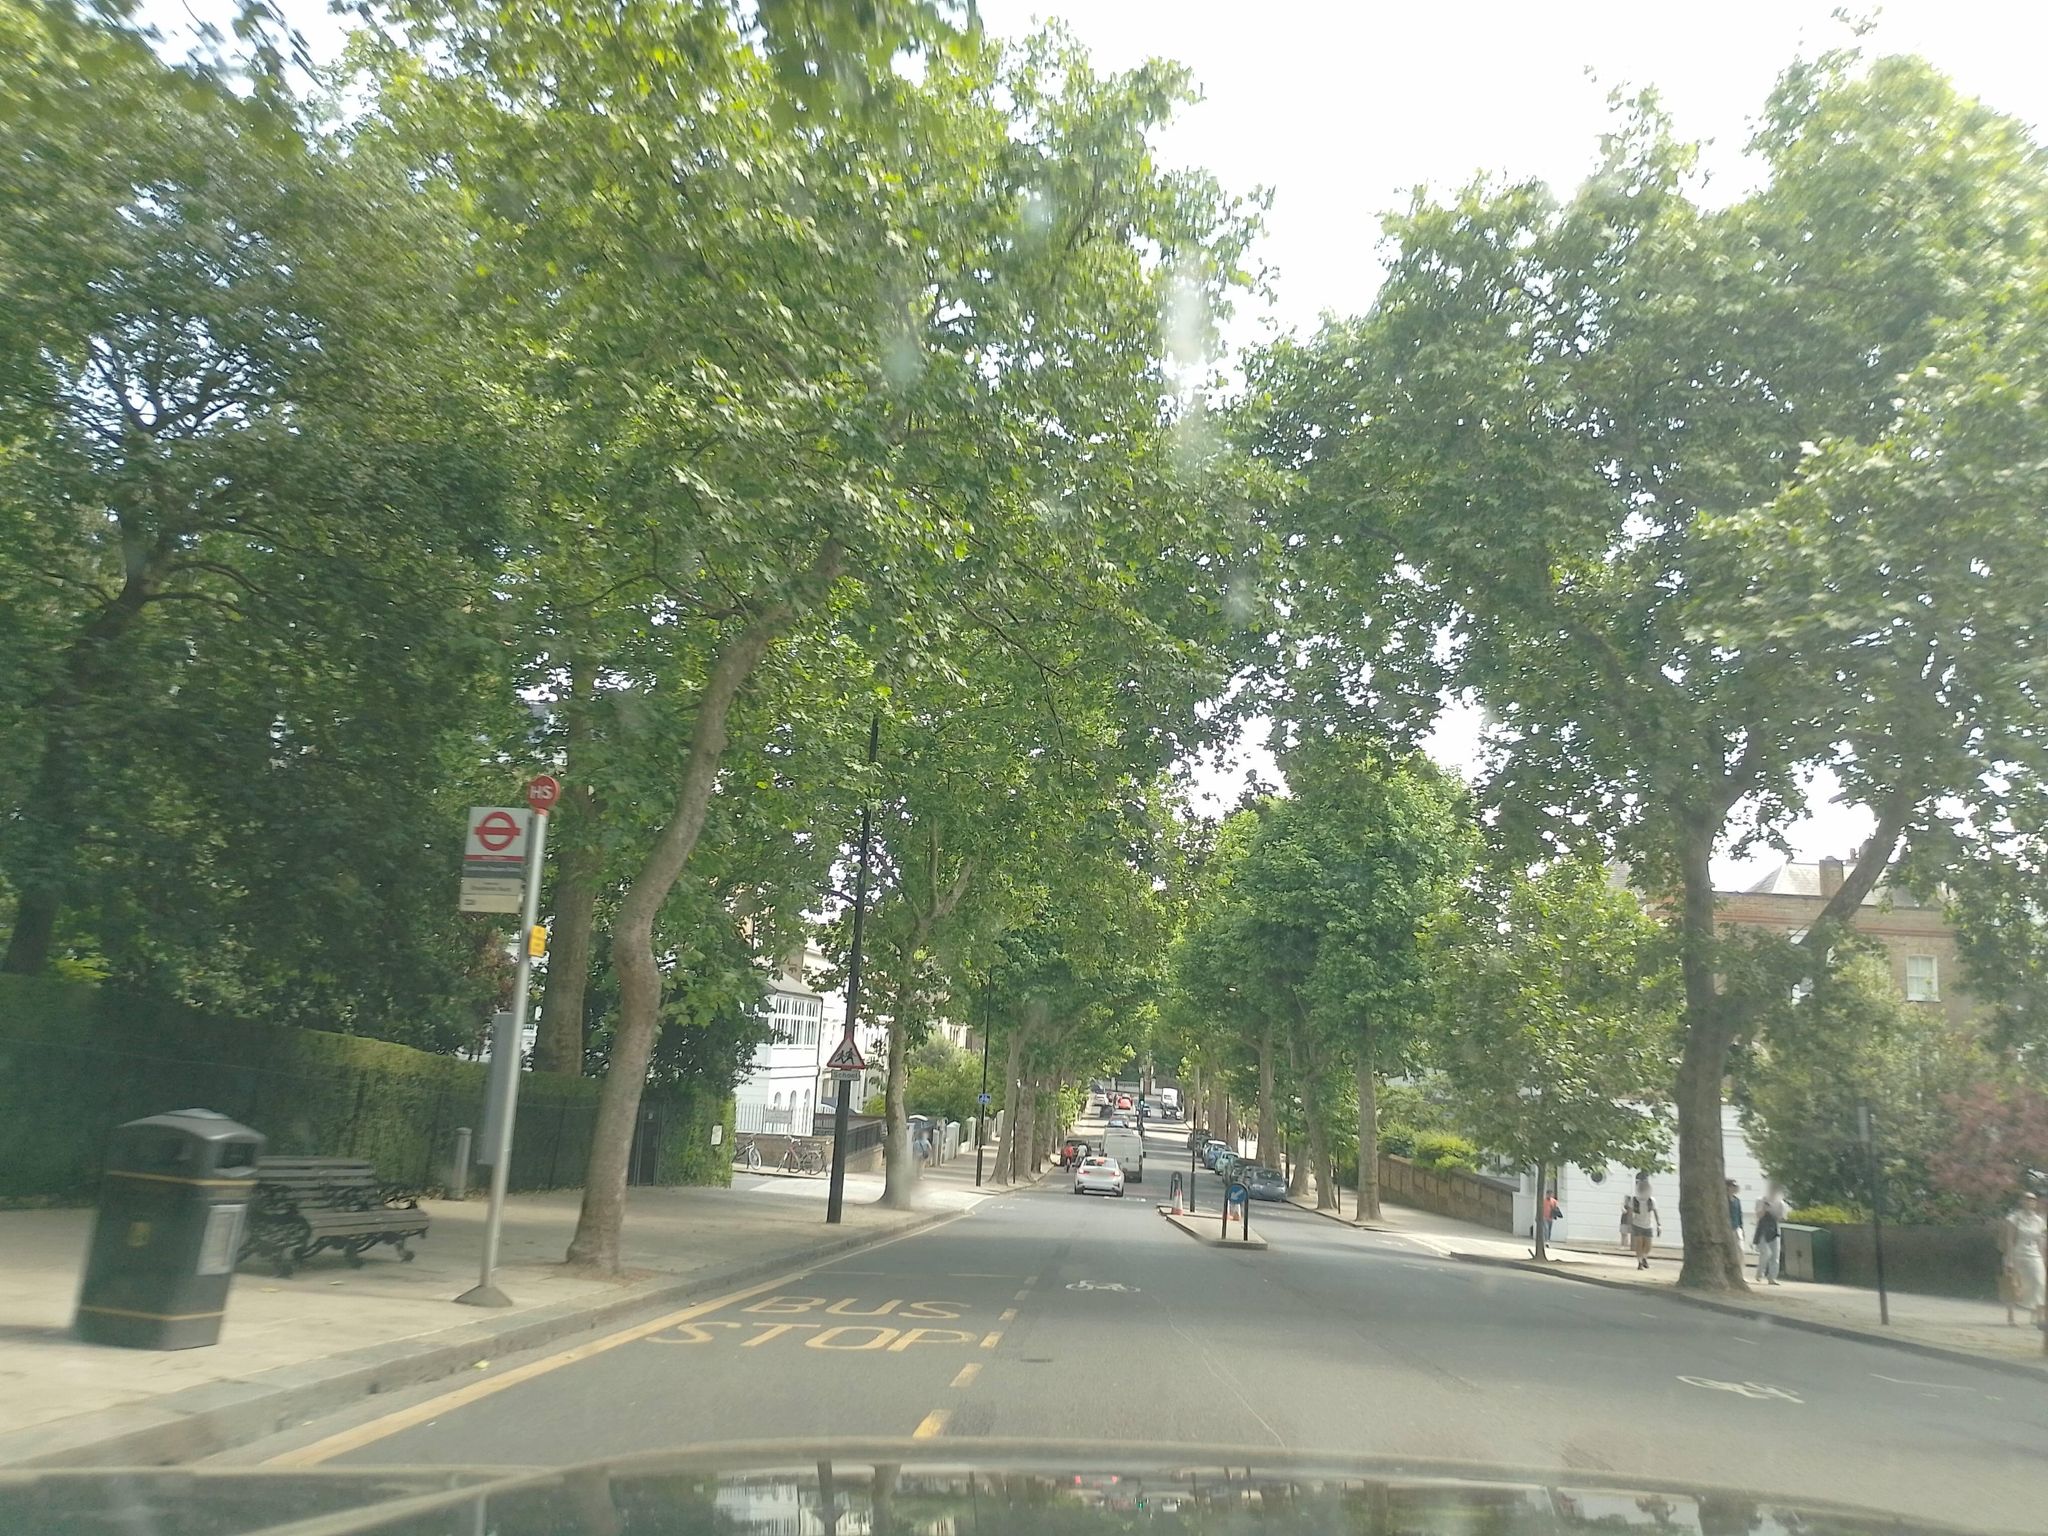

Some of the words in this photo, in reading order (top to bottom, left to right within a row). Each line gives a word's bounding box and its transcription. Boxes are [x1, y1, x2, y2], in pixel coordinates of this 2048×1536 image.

[530, 785, 553, 799] HS
[741, 1296, 972, 1319] BUS
[645, 1321, 978, 1352] STOP
